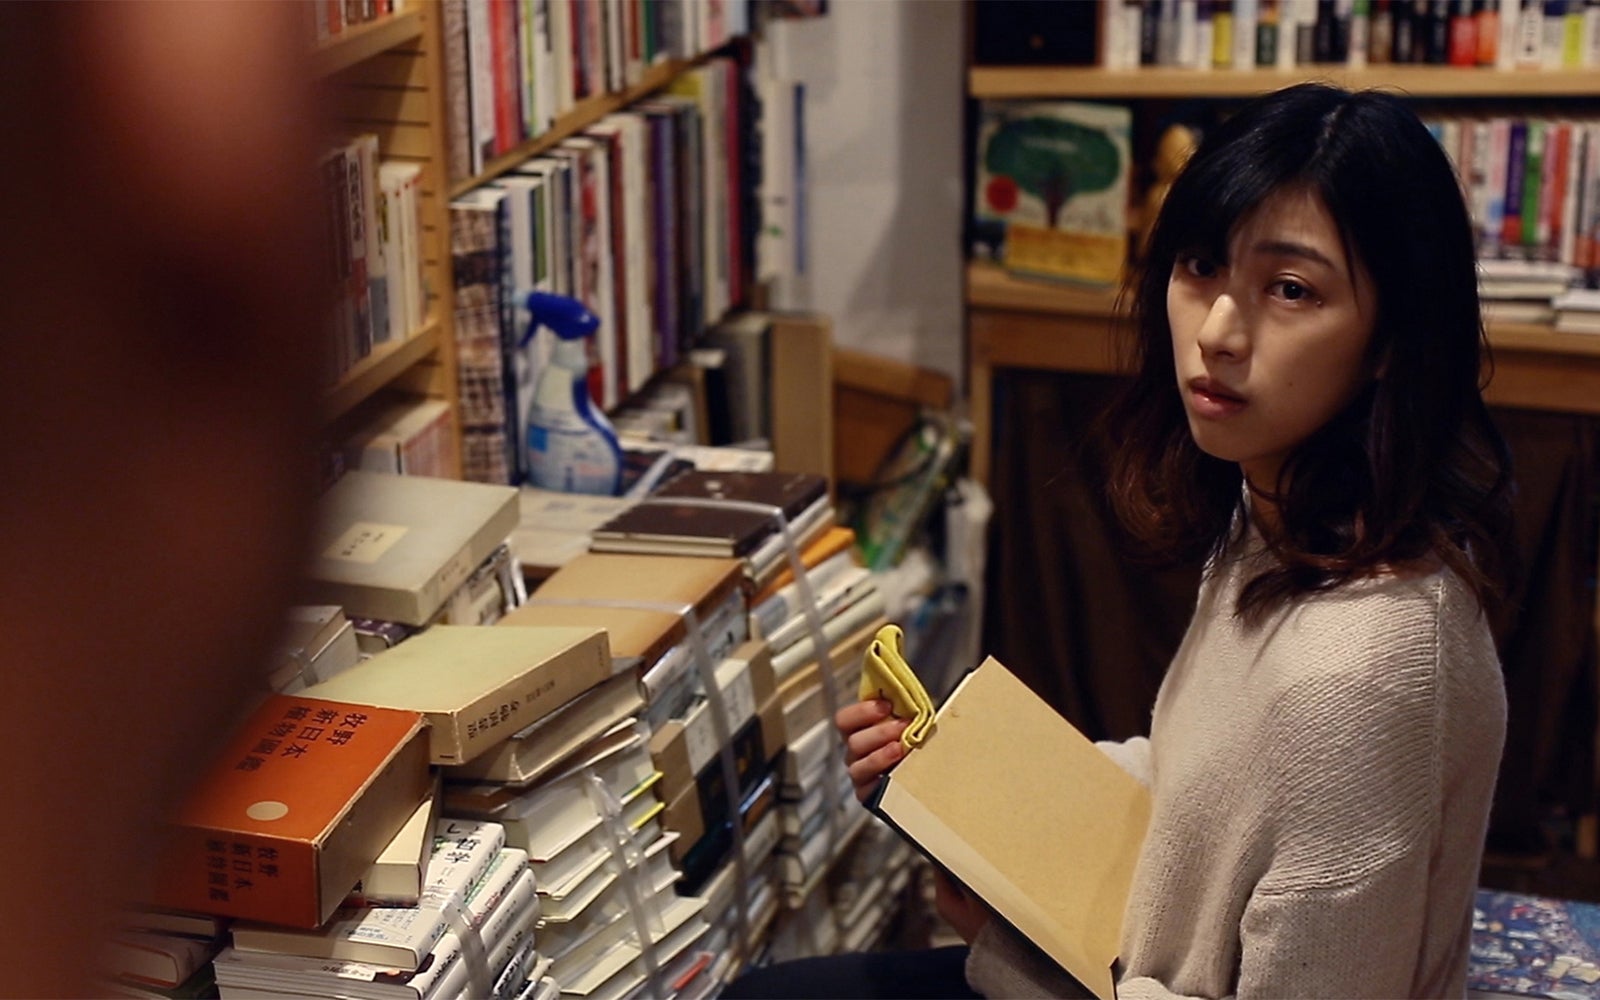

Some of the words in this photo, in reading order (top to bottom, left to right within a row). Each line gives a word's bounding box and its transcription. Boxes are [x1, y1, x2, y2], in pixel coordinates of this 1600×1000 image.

[280, 708, 339, 758] 新日本
[327, 713, 368, 745] 牧野
